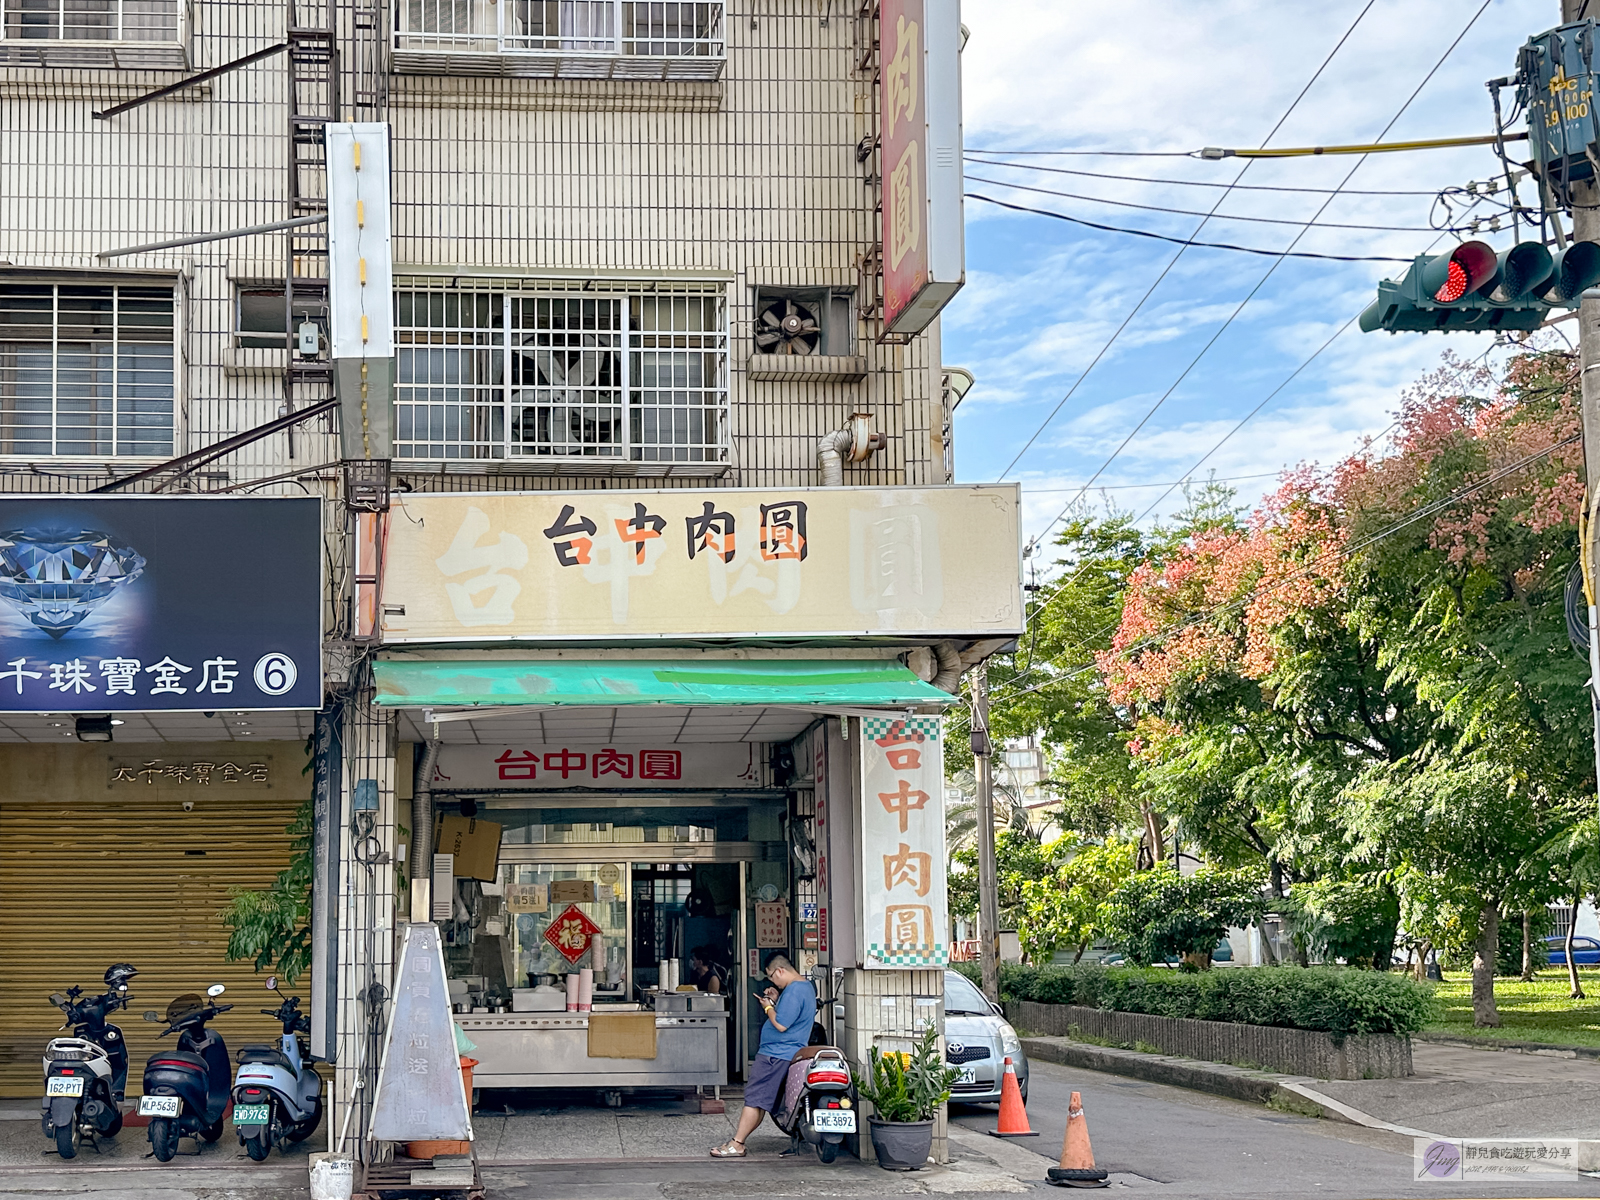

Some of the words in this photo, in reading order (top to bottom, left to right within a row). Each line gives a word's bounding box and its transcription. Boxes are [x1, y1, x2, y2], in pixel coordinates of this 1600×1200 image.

[887, 14, 920, 273] 肉圓
[543, 500, 808, 567] 台中肉圓
[0, 656, 239, 696] 千珠寶金店
[494, 748, 682, 780] 台中肉圓
[874, 719, 936, 960] 台中肉圓
[807, 909, 818, 918] 27
[49, 1083, 82, 1094] 162-PYT
